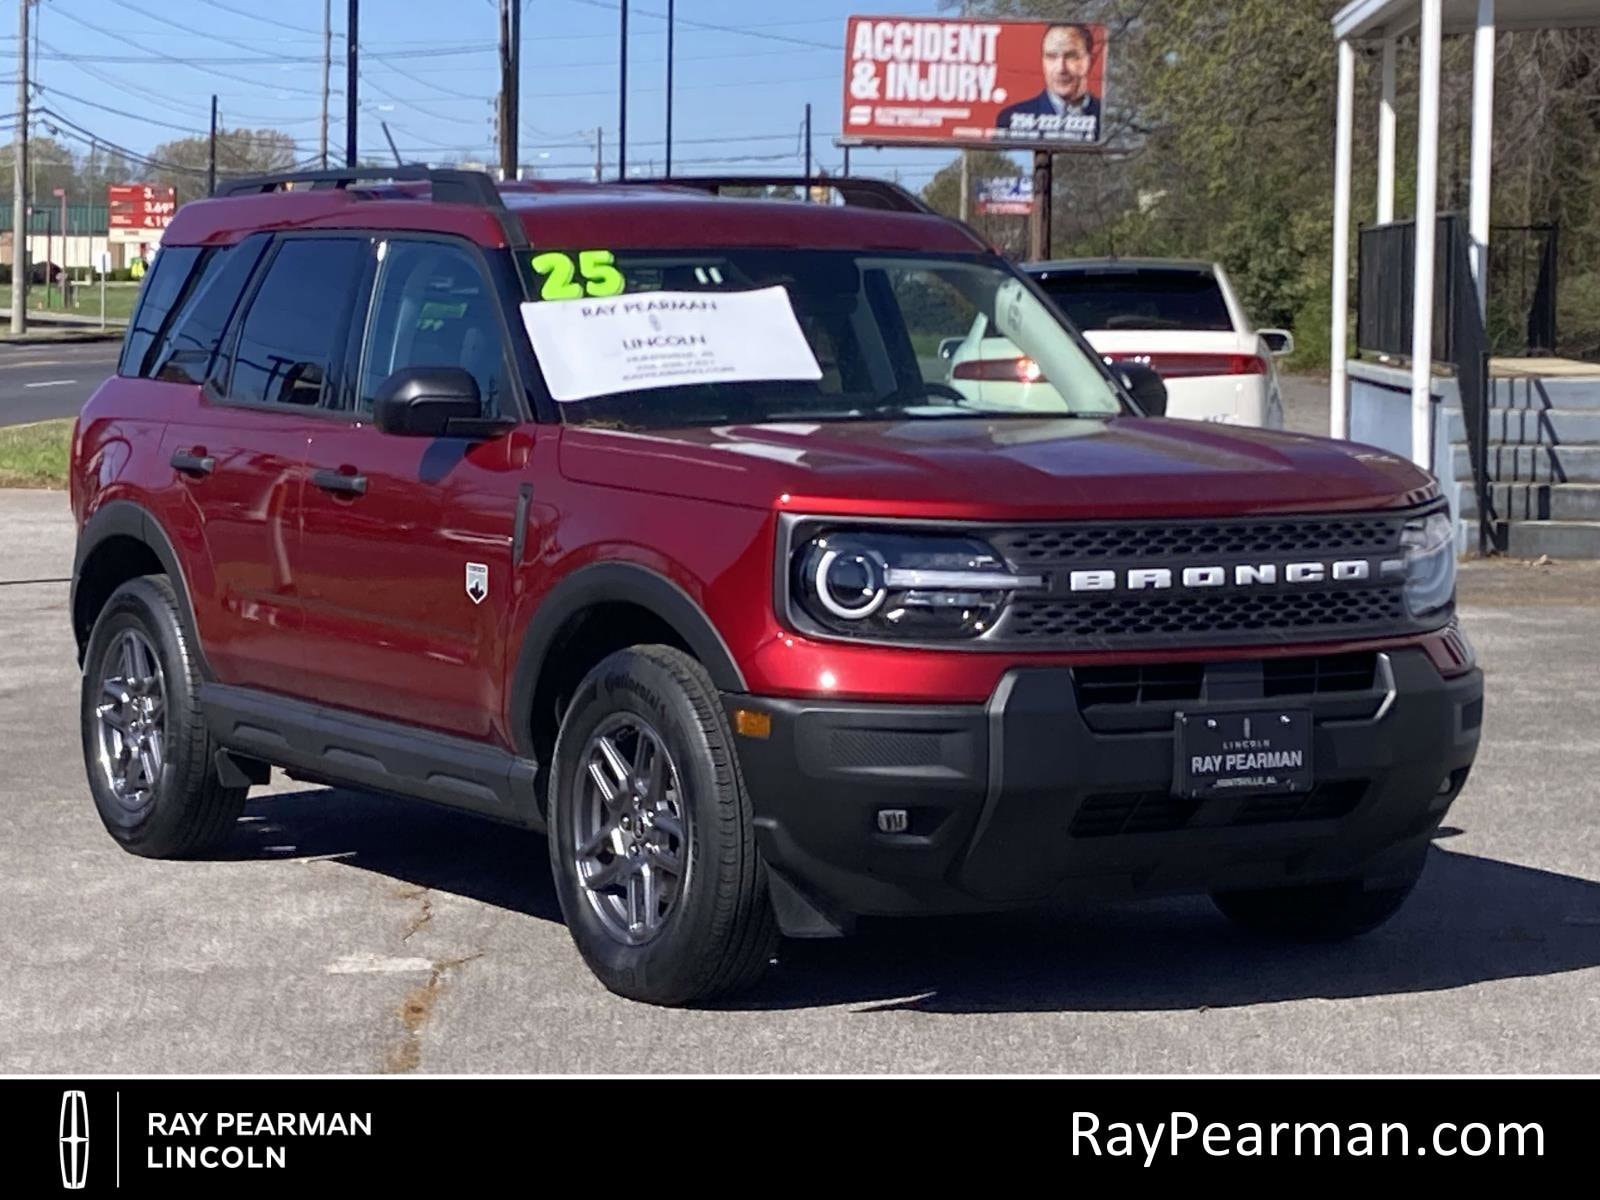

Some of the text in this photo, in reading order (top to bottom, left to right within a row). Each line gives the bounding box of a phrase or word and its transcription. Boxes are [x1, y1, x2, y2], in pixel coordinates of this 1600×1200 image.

[852, 21, 1002, 62] ACCIDENT
[850, 61, 1008, 104] & INJURY.
[531, 250, 626, 300] 25
[582, 300, 718, 318] RAY PEARMAN
[622, 334, 707, 351] LINCOLN
[1070, 560, 1369, 591] BRONCO
[1223, 739, 1271, 751] LINCOLN
[1191, 750, 1303, 774] RAY PEARMAN
